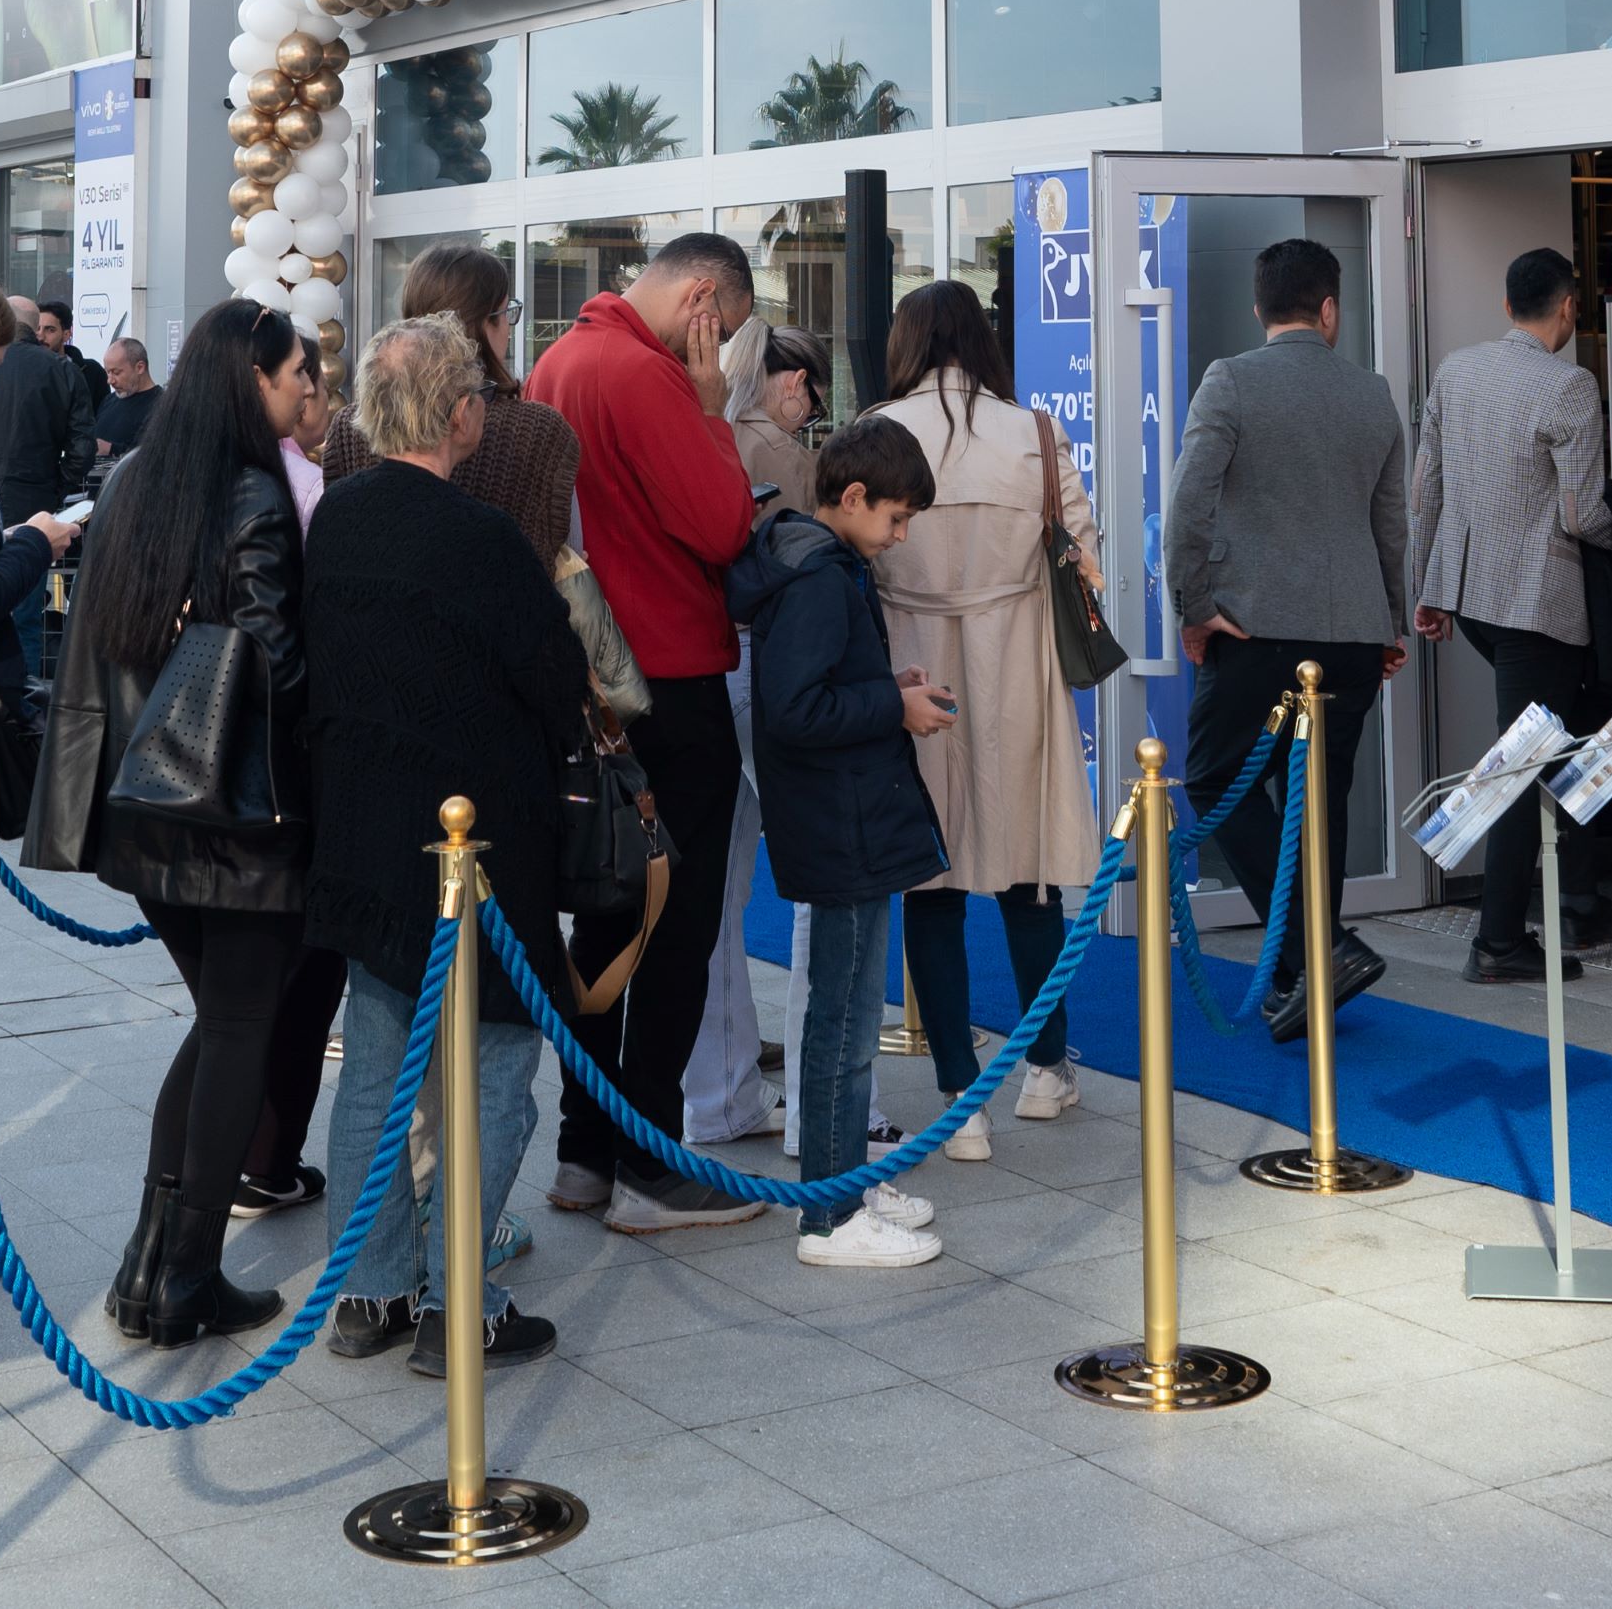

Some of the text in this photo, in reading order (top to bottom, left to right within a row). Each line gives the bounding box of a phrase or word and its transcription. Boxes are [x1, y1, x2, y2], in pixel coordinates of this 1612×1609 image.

[81, 101, 101, 117] vivo
[79, 187, 96, 205] V30
[97, 183, 122, 202] Serisi
[82, 218, 123, 252] 4 YIL
[91, 253, 124, 269] GARANTİSİ
